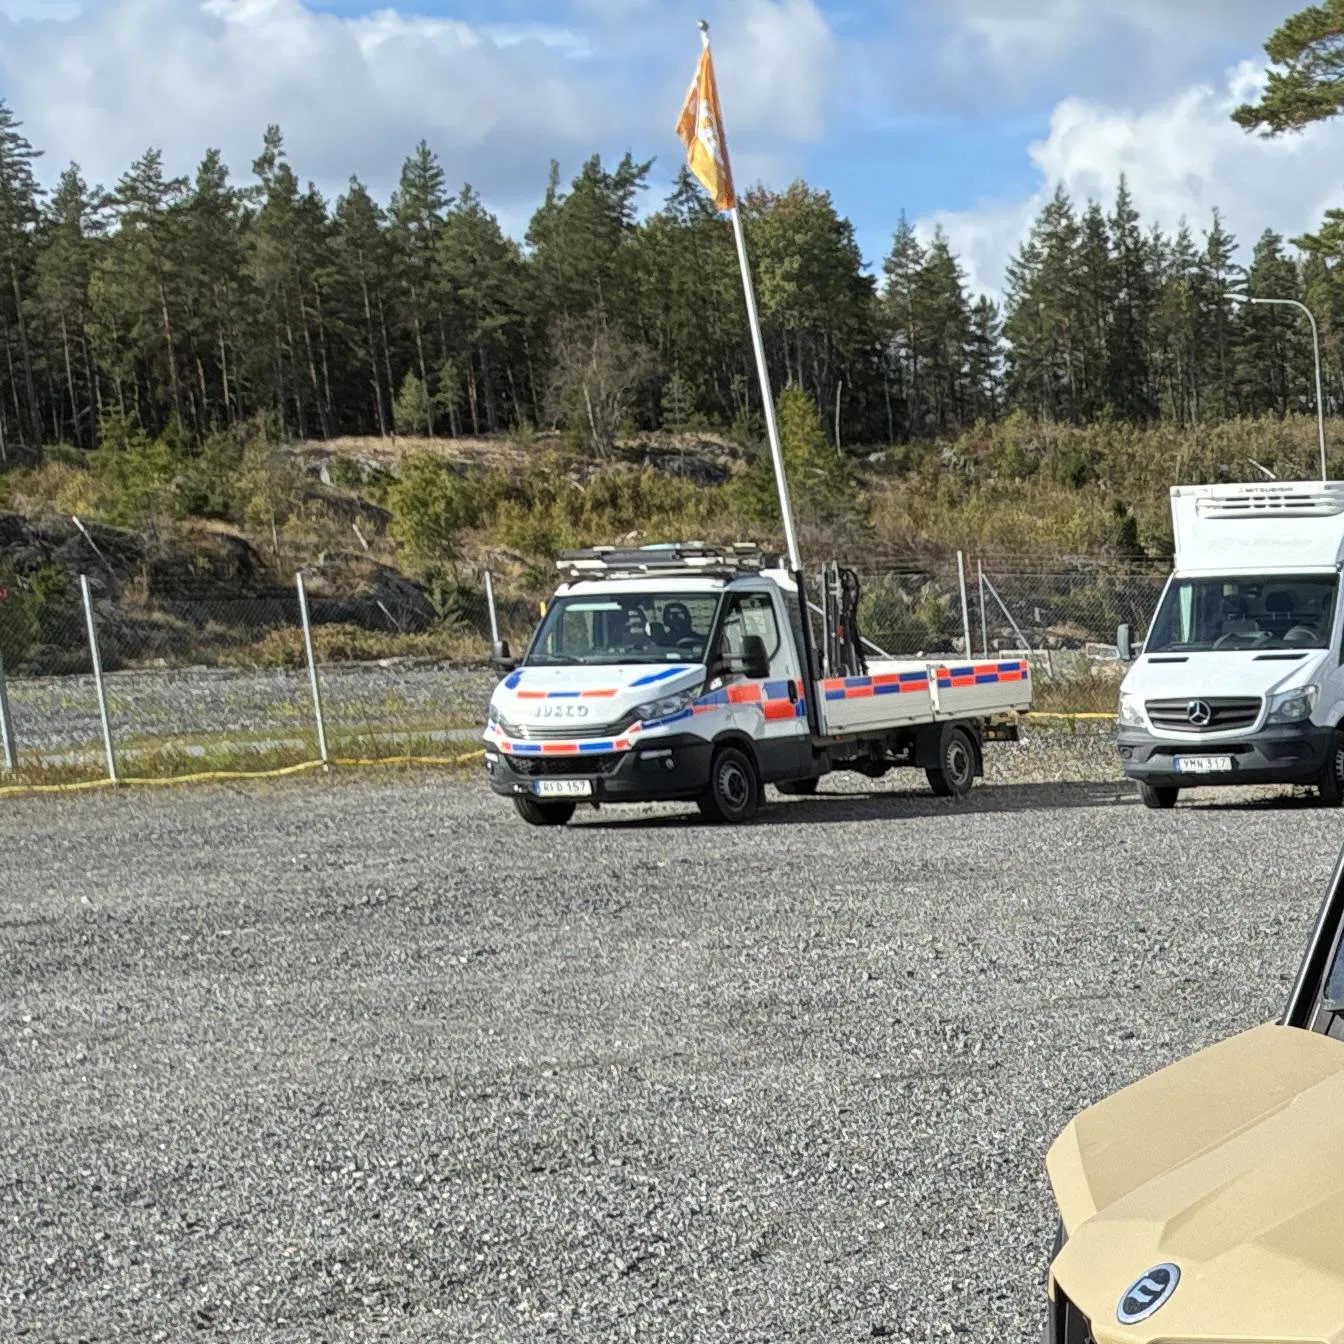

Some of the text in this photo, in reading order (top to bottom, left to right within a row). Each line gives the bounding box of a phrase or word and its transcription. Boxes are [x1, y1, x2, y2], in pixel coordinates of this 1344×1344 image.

[1184, 758, 1226, 769] YMN 317
[567, 781, 586, 792] 157
